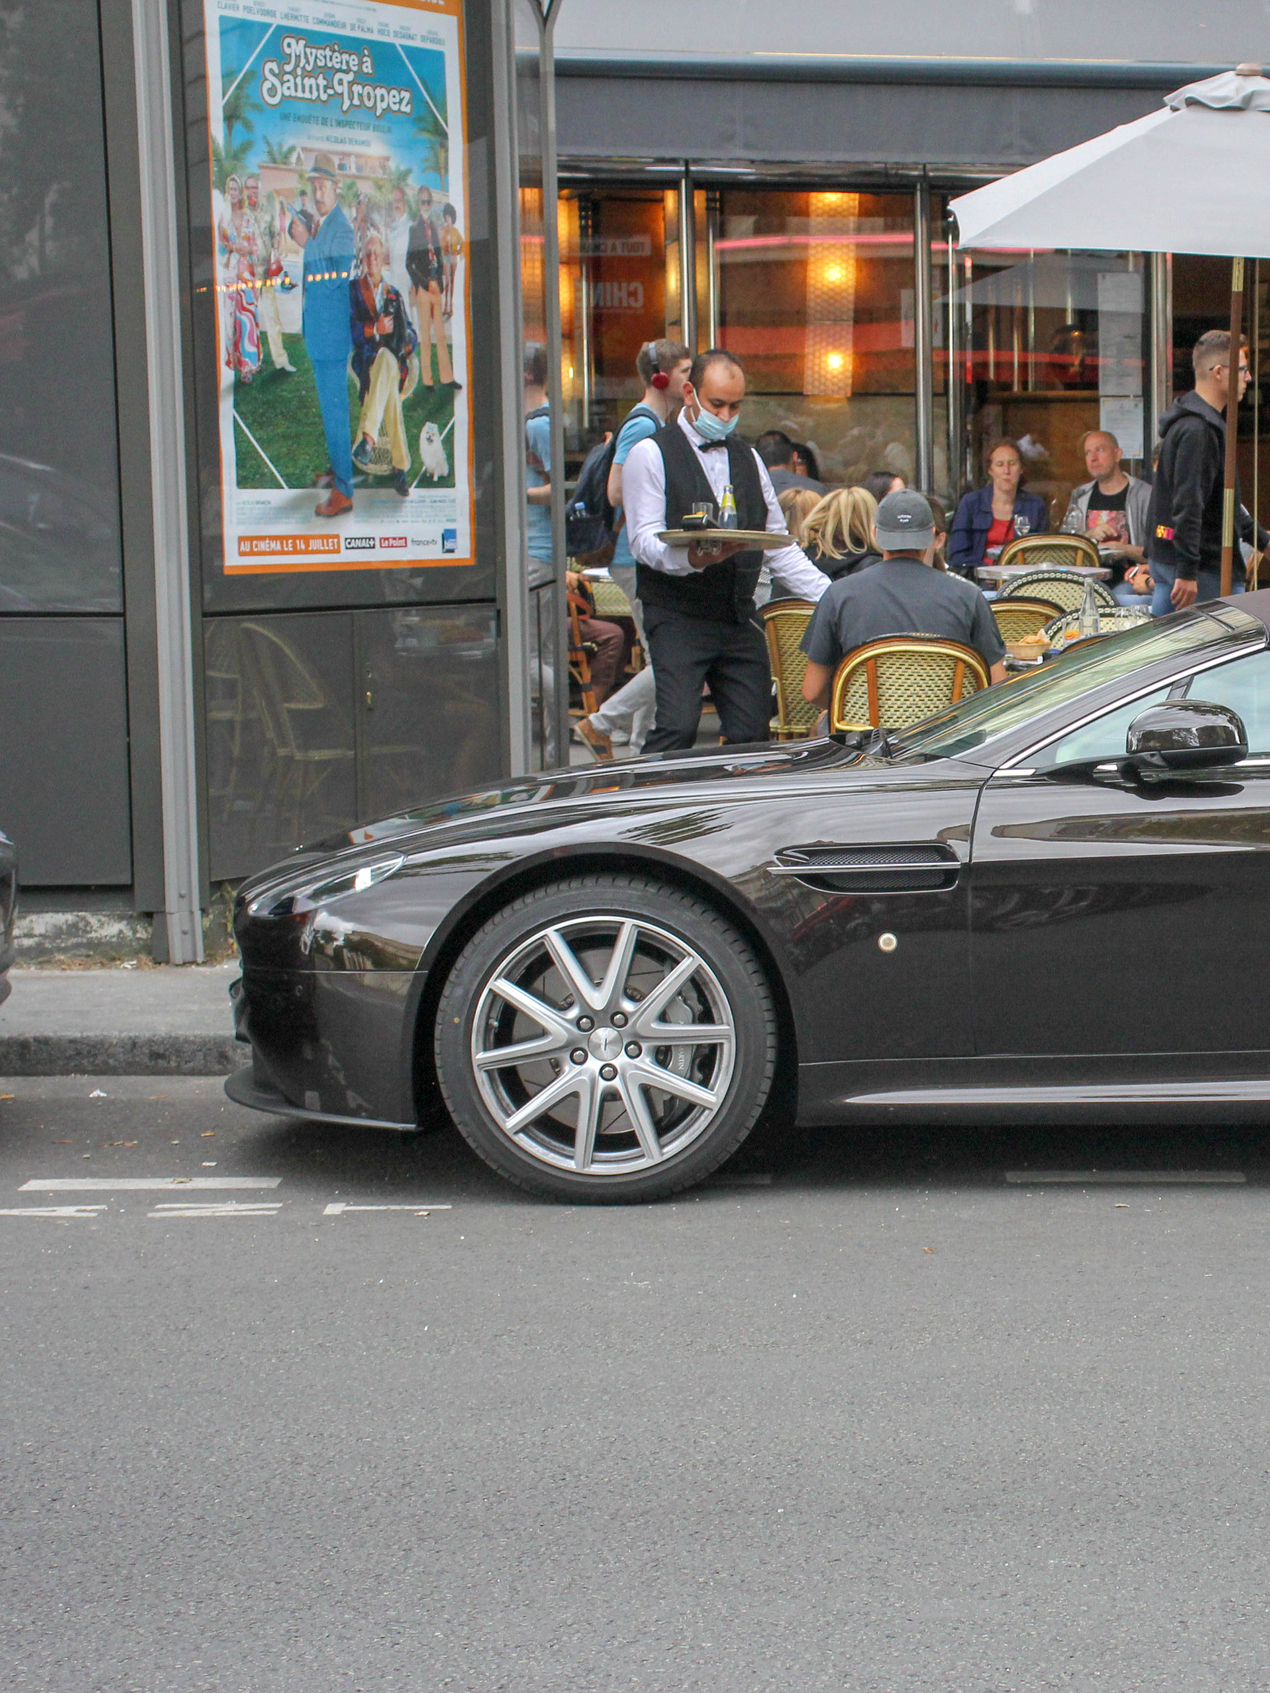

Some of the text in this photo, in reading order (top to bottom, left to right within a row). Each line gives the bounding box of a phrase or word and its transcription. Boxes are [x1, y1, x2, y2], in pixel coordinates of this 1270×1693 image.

[282, 36, 373, 74] Mystère à
[262, 61, 411, 117] Saint-Tropez
[240, 538, 338, 551] AU CINÉMA LE 14 JUILLET
[345, 538, 375, 548] CANAL+
